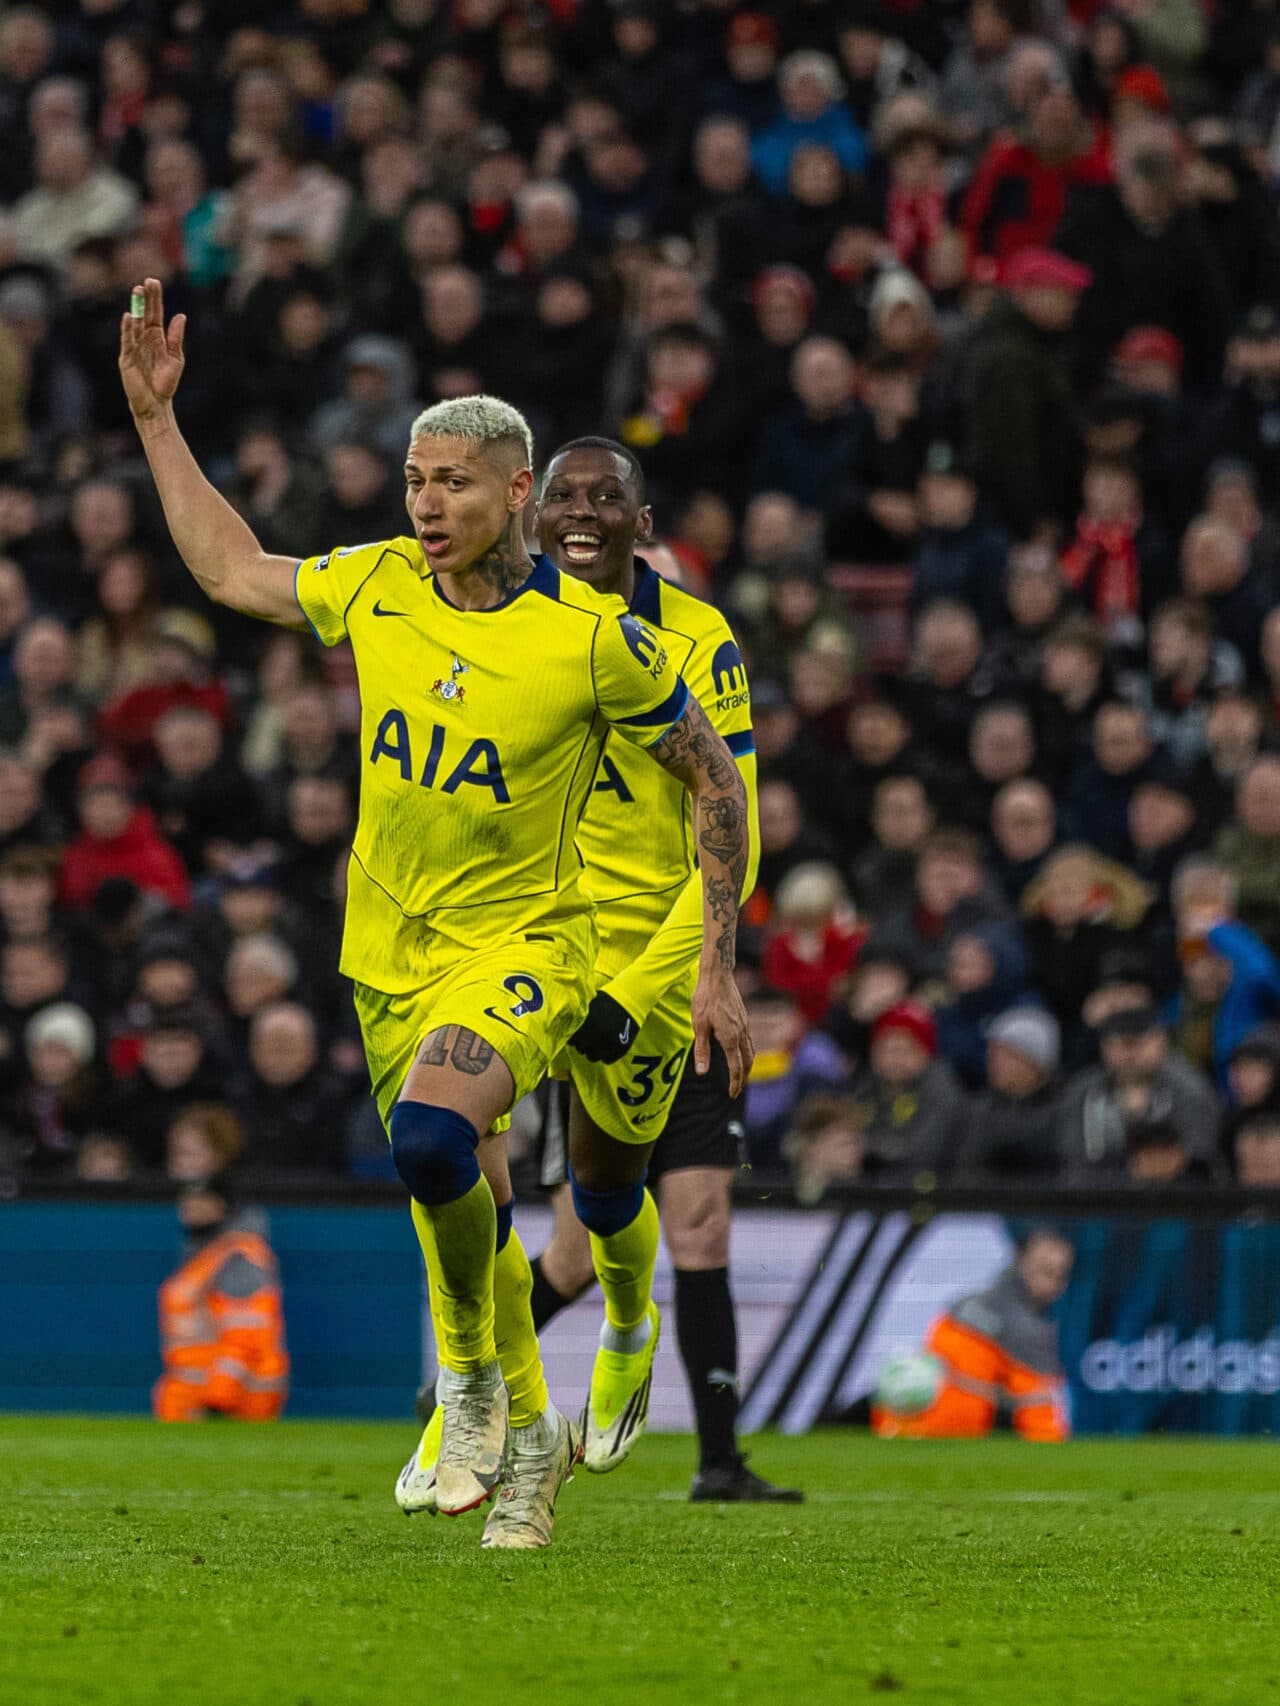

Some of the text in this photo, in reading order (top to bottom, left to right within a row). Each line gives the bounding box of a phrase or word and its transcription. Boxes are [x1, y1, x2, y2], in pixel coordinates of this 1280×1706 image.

[370, 708, 511, 803] AIA
[503, 974, 544, 1018] 9
[617, 1046, 687, 1106] 39
